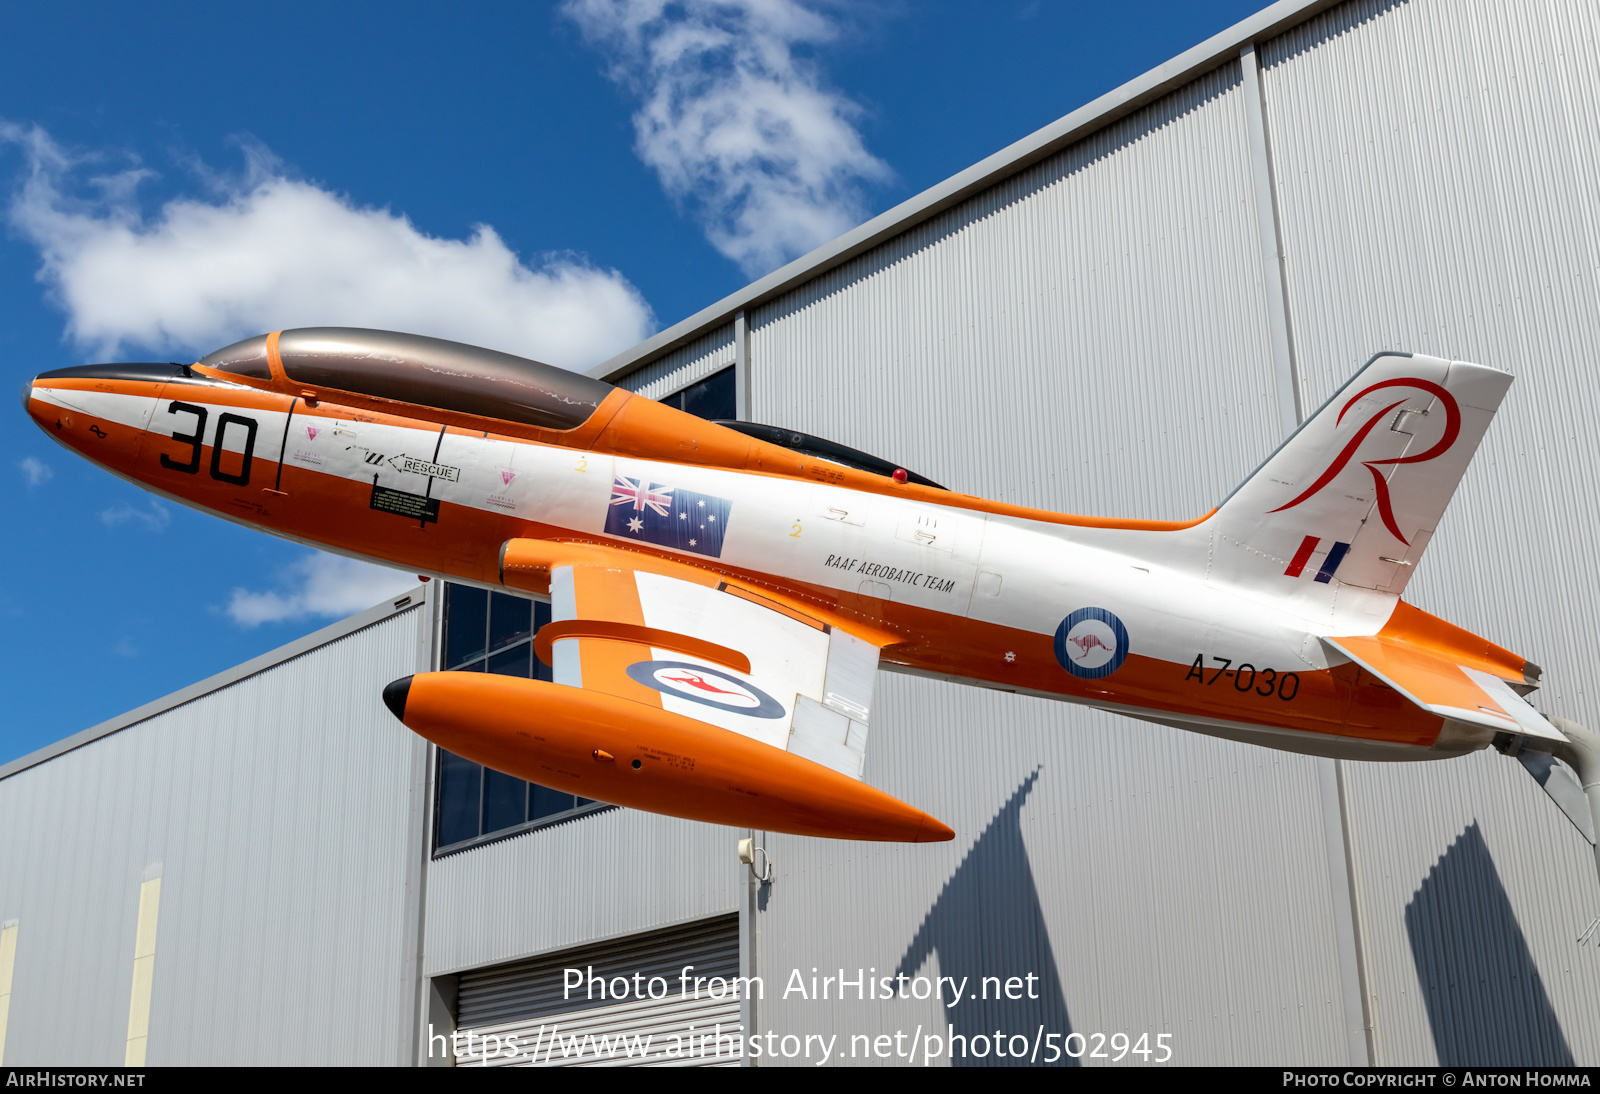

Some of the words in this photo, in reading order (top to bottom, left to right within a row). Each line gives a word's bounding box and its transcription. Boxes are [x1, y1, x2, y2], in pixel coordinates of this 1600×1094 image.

[160, 401, 258, 487] 30
[1265, 377, 1461, 546] R
[404, 459, 453, 479] RESCUE
[574, 459, 587, 473] 2
[789, 524, 803, 539] 2
[825, 554, 858, 572] RAAF
[857, 561, 922, 585] AEROBATIC
[923, 576, 956, 593] TEAM
[1185, 654, 1300, 702] A7-030
